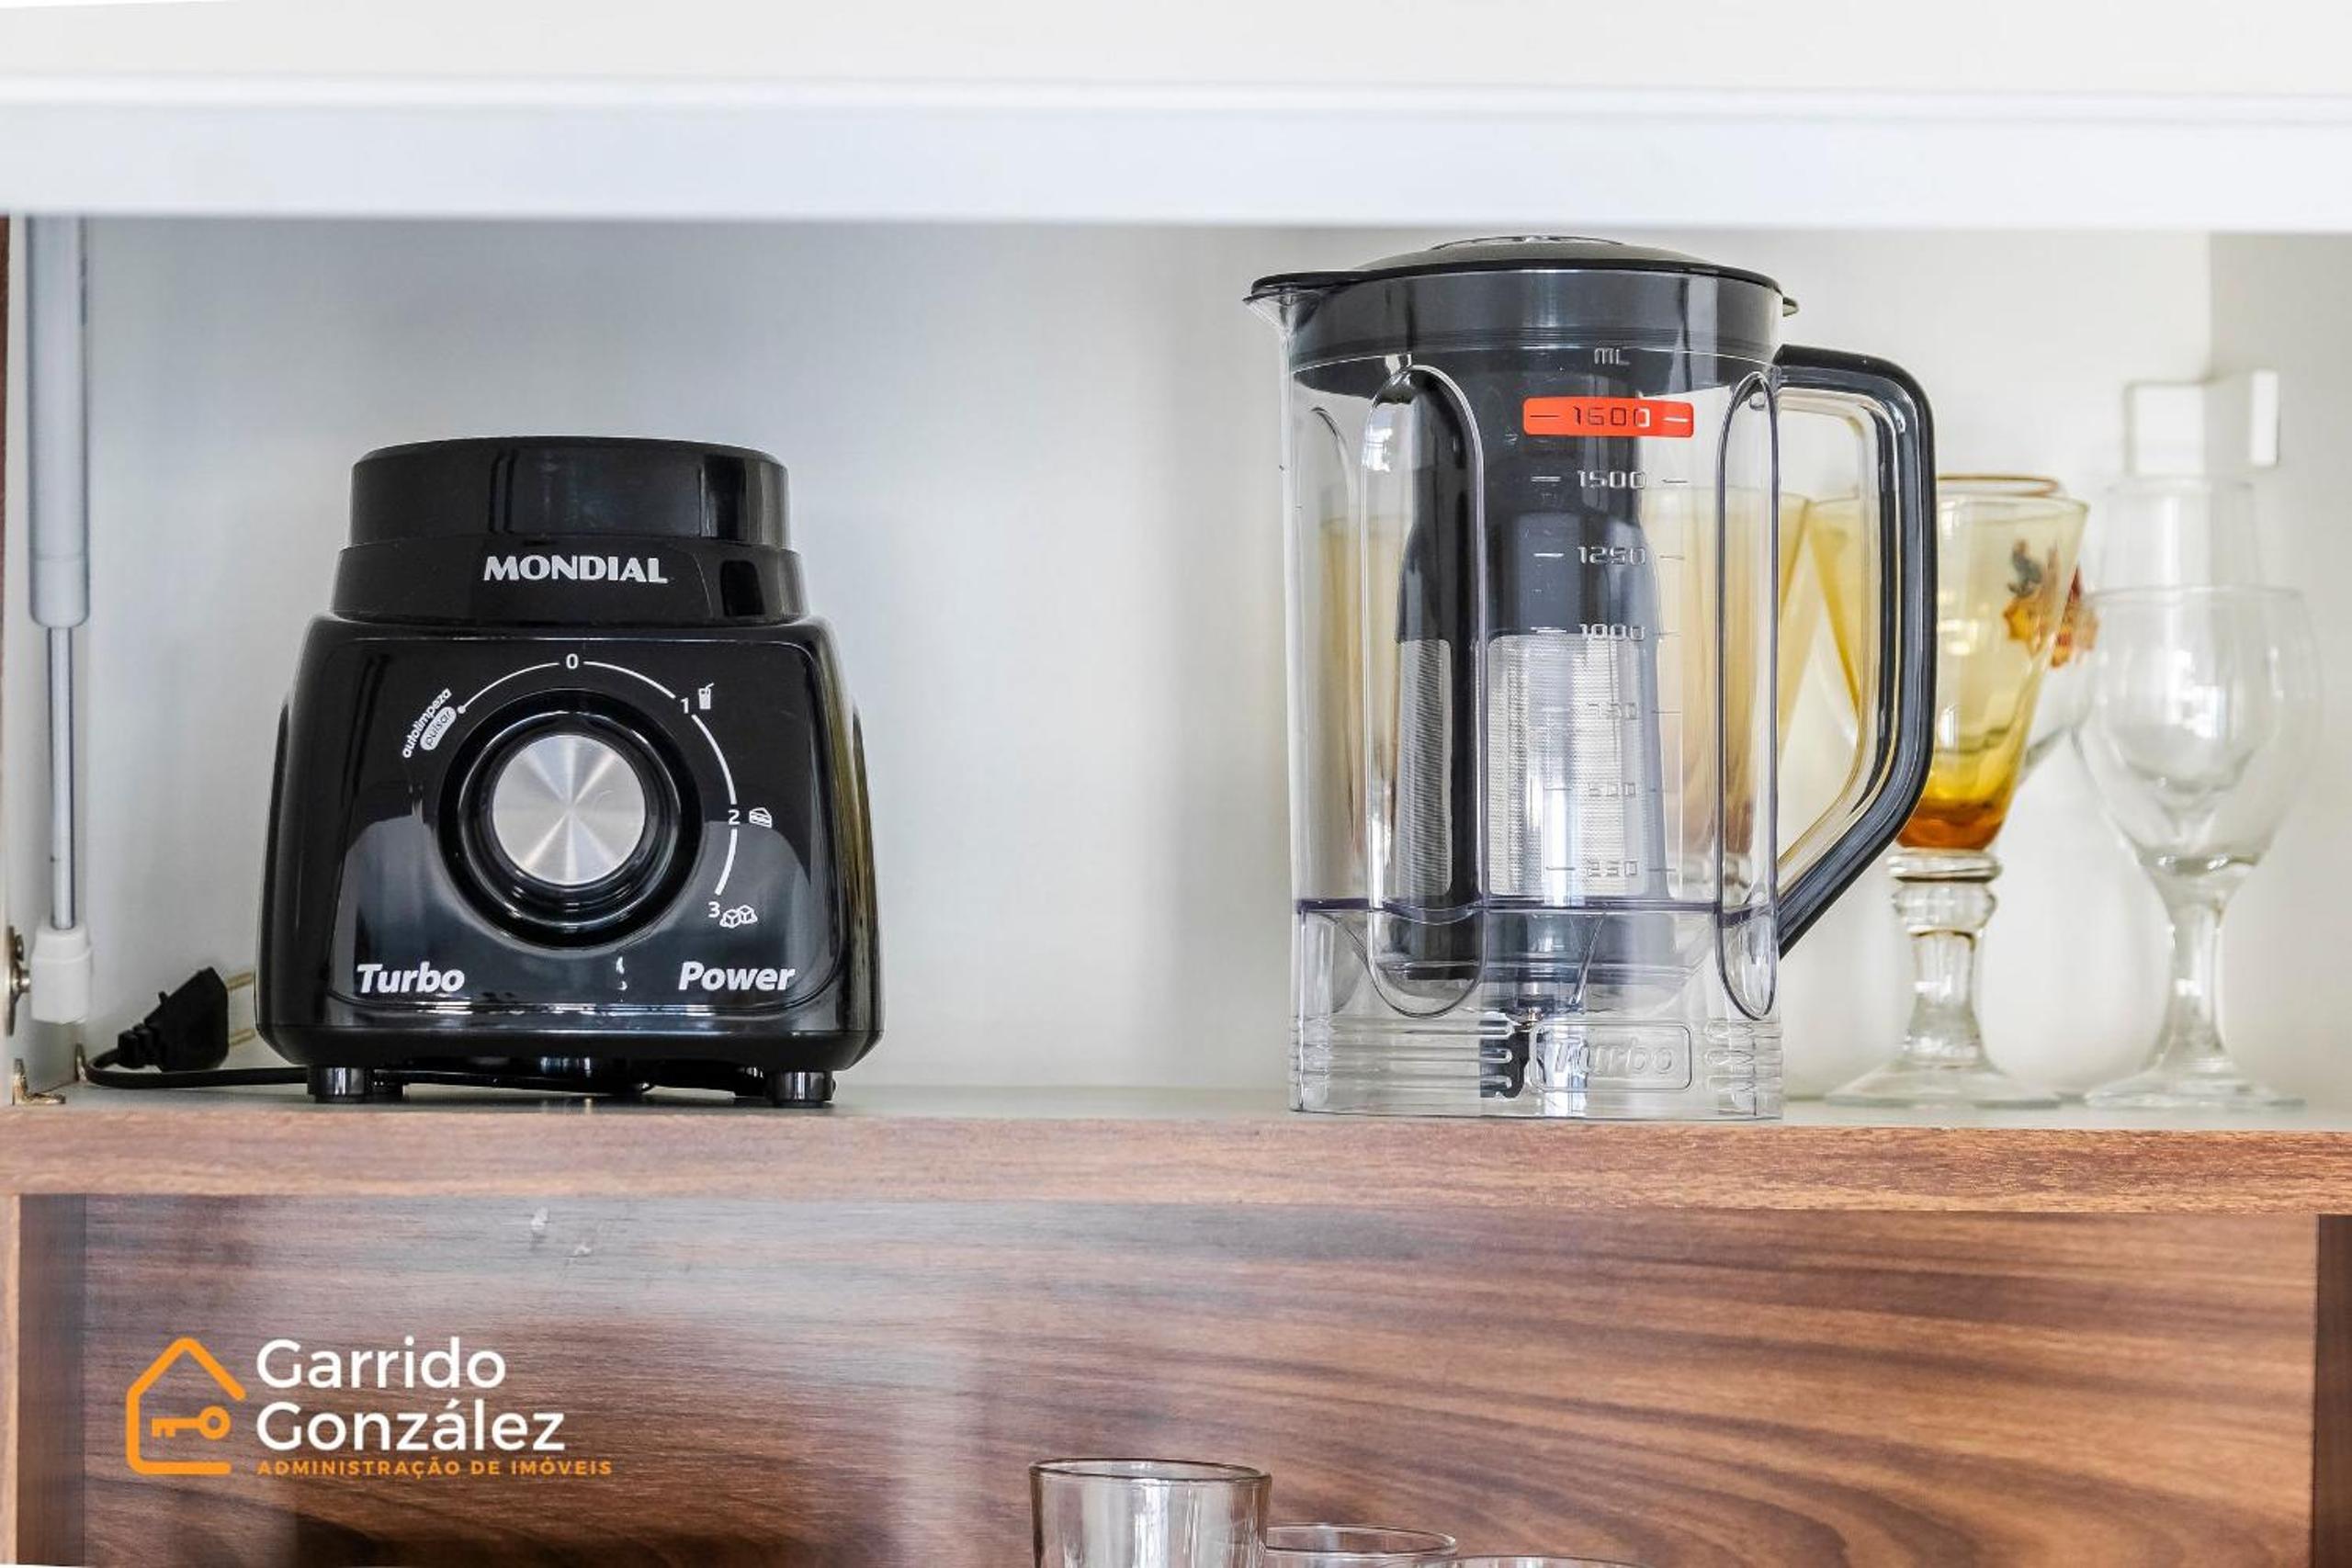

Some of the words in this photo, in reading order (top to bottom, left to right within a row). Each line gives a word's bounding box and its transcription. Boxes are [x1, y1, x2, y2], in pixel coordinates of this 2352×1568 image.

[1577, 469, 1646, 490] 1500
[1577, 546, 1646, 566] 1250
[483, 555, 668, 583] MONDIAL
[1579, 623, 1645, 642] 1000
[565, 653, 580, 670] 0
[680, 697, 690, 715] 1
[402, 688, 452, 758] autolimpeza
[424, 710, 452, 747] pulsar
[728, 809, 741, 825] 2
[707, 901, 720, 919] 3
[356, 963, 466, 993] Turbo
[678, 961, 796, 991] Power
